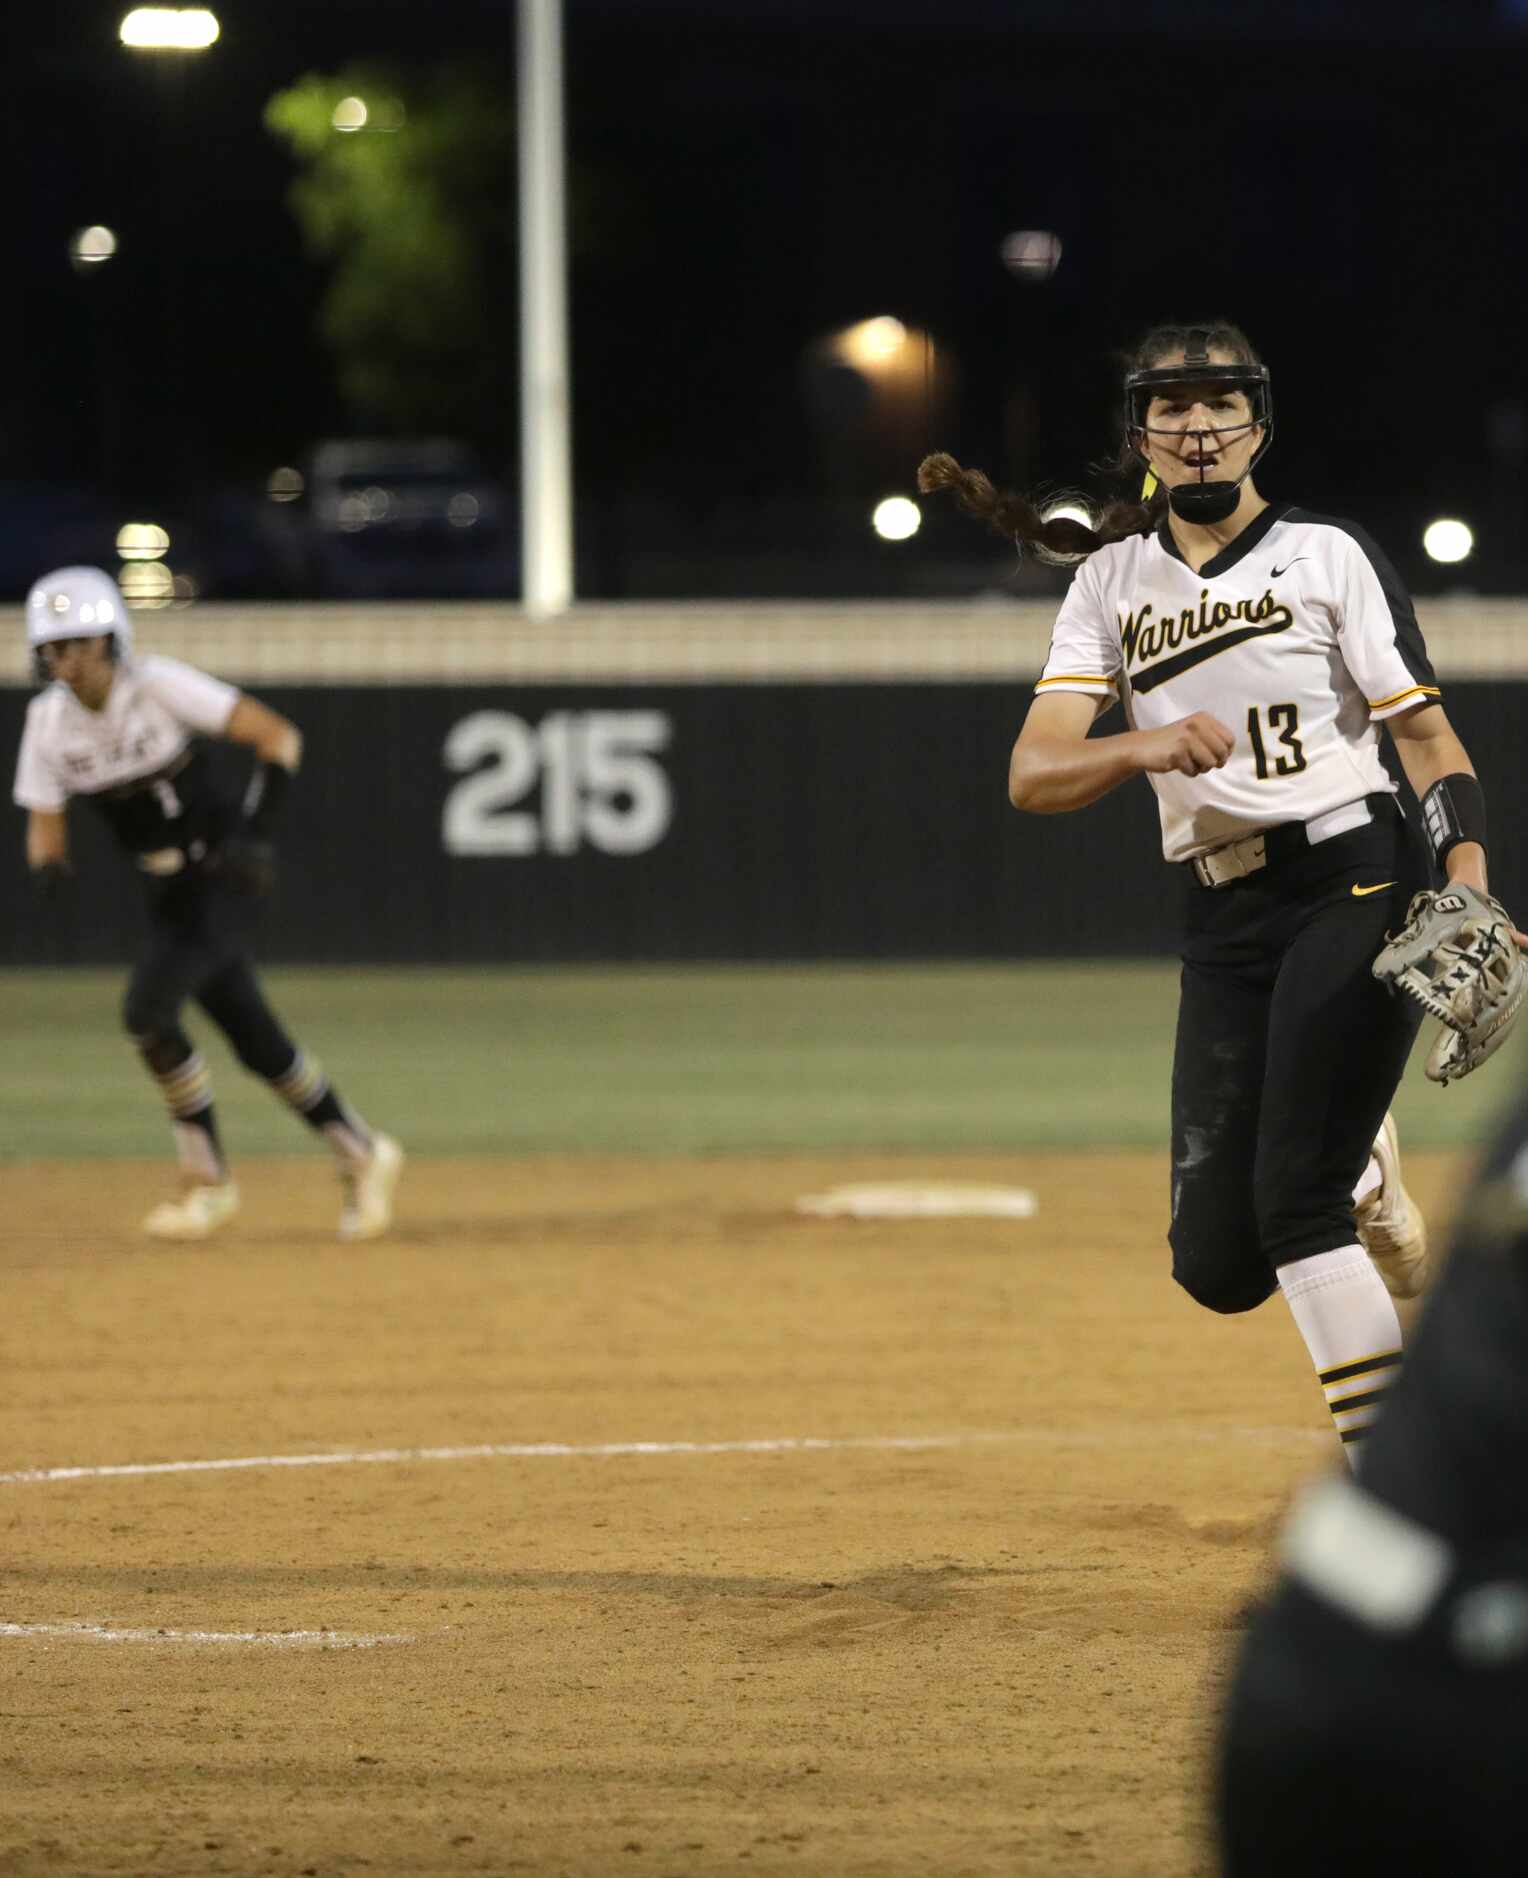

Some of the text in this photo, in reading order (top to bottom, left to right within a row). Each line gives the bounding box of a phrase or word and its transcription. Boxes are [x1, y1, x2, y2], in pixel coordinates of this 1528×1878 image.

[1118, 588, 1288, 672] Warriors
[443, 710, 671, 856] 215
[1247, 703, 1307, 780] 13
